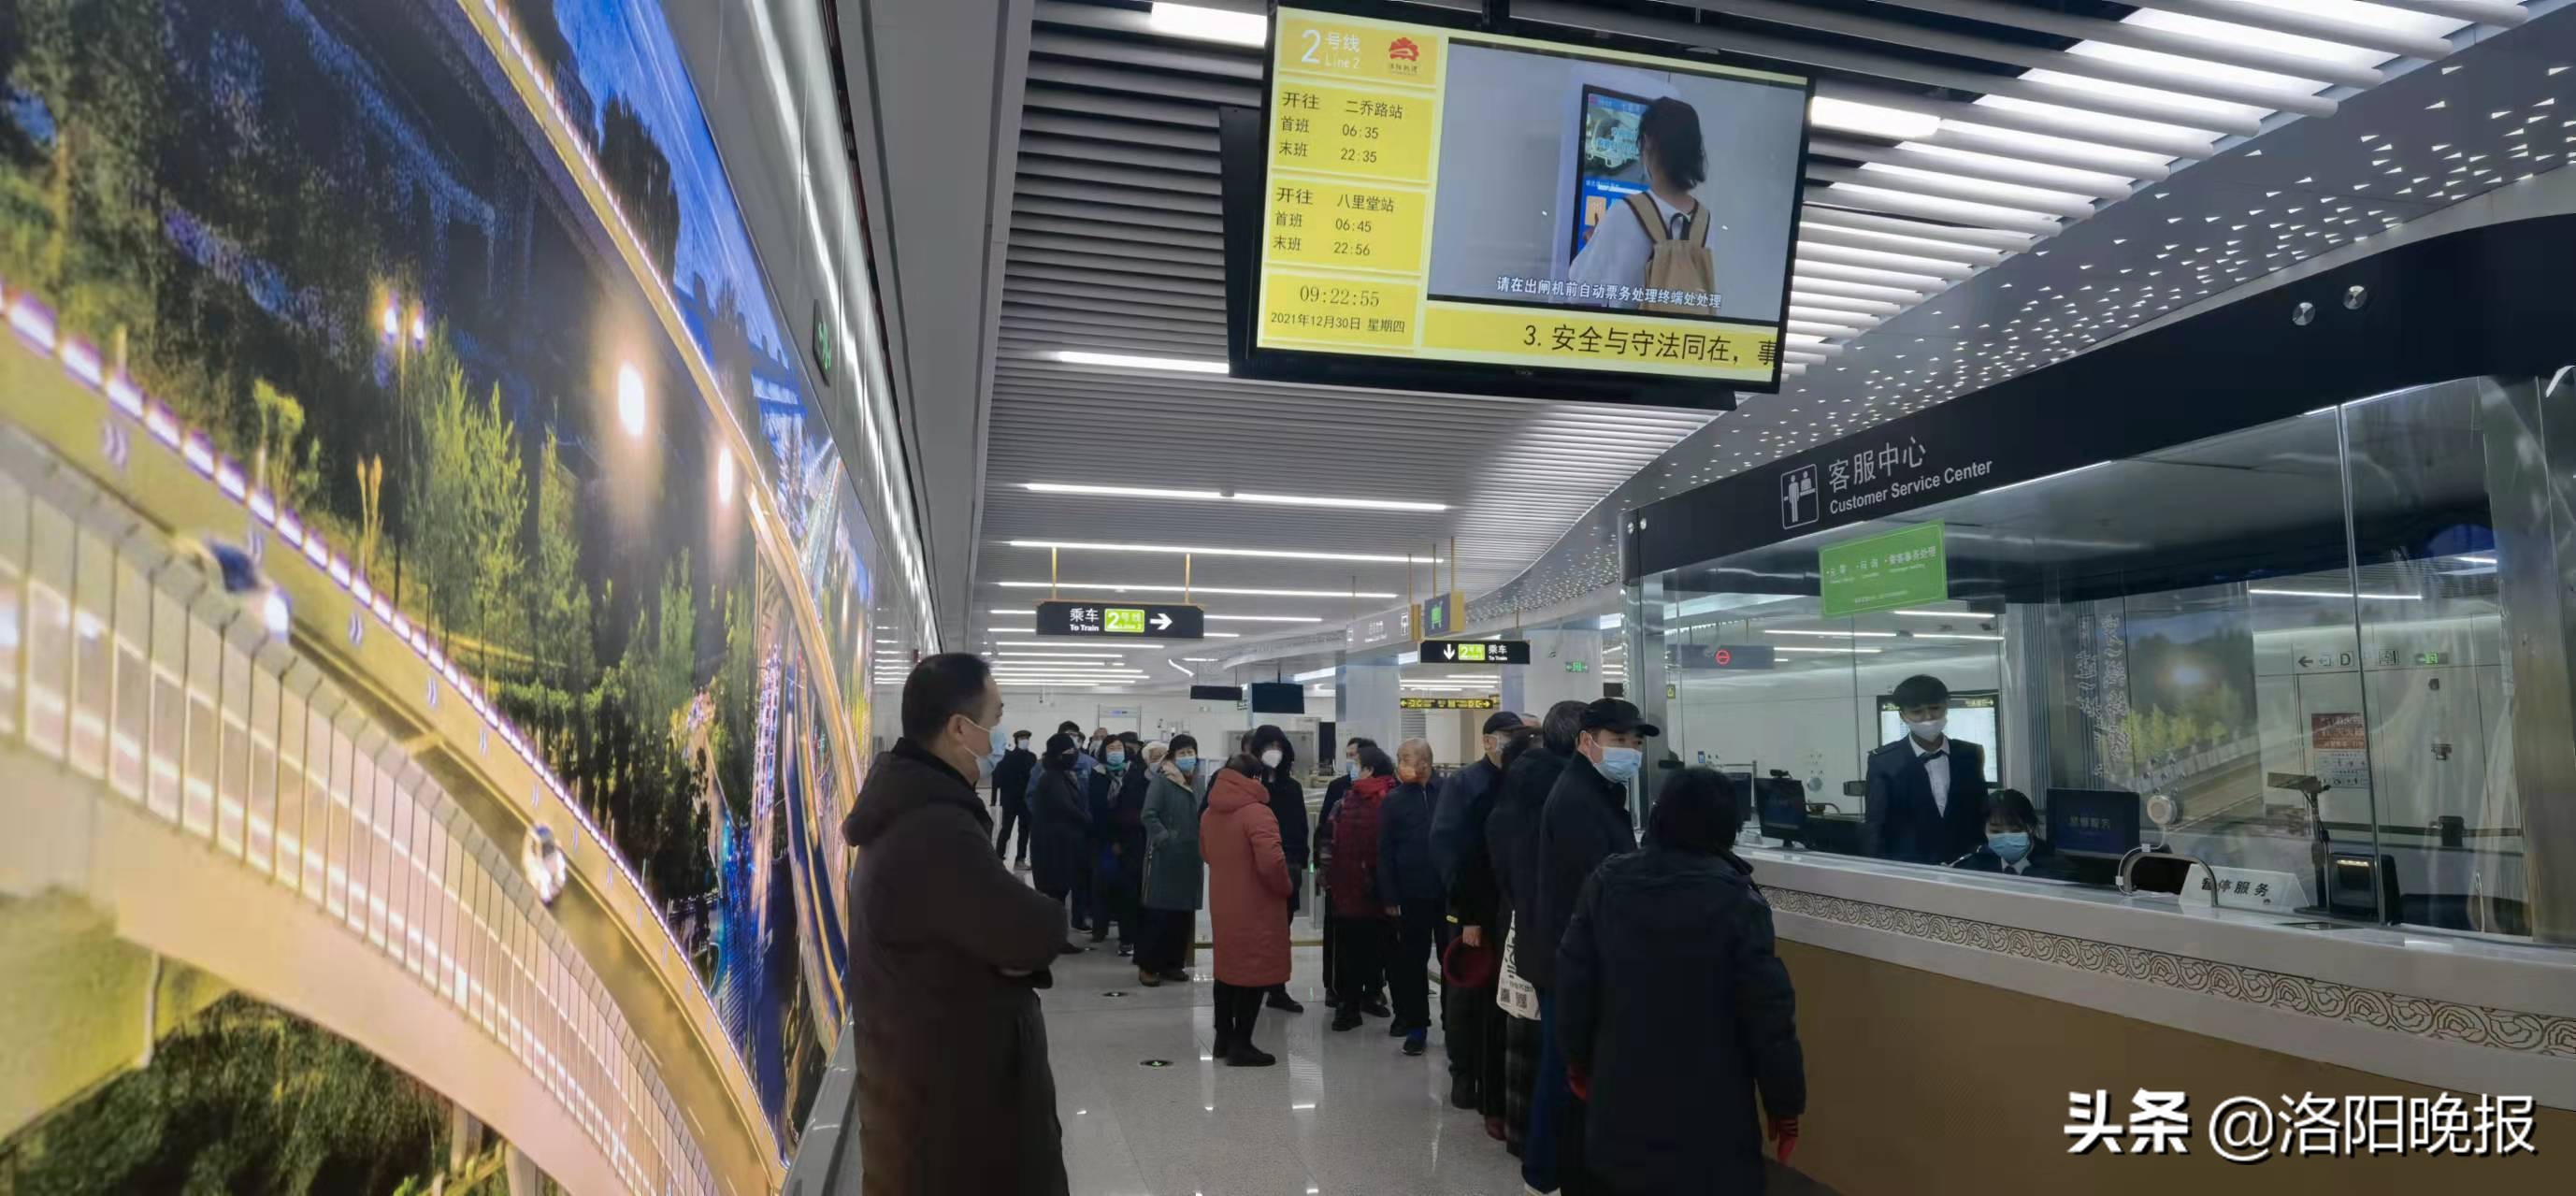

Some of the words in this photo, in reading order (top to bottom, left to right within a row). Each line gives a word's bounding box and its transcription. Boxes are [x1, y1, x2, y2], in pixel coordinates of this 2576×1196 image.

[1325, 52, 1349, 67] Line
[1282, 91, 1320, 110] 开往
[1344, 100, 1403, 120] 二乔路站
[1281, 116, 1310, 133] 首班
[1342, 123, 1379, 139] 06:35
[1278, 139, 1308, 157] 末班
[1340, 148, 1377, 163] 22:35
[1276, 187, 1314, 205] 开往
[1336, 194, 1395, 213] 八里堂站
[1275, 211, 1302, 228] 首班
[1335, 218, 1372, 233] 06:45
[1273, 236, 1302, 252] 末班
[1333, 241, 1371, 256] 22:56
[1299, 285, 1380, 307] 09:22:55
[1496, 276, 1722, 309] 请在出闸机前自动票务处理终端处处理
[1271, 312, 1361, 330] 2021年12月30日
[1367, 318, 1405, 333] 星期四
[1828, 436, 1926, 494] 客服中心
[1830, 488, 1888, 514] Customer
[1891, 475, 1940, 498] Service
[1944, 460, 1993, 483] Center
[1070, 608, 1100, 623] 乘车
[1081, 624, 1100, 632] Train
[2340, 654, 2351, 666] D
